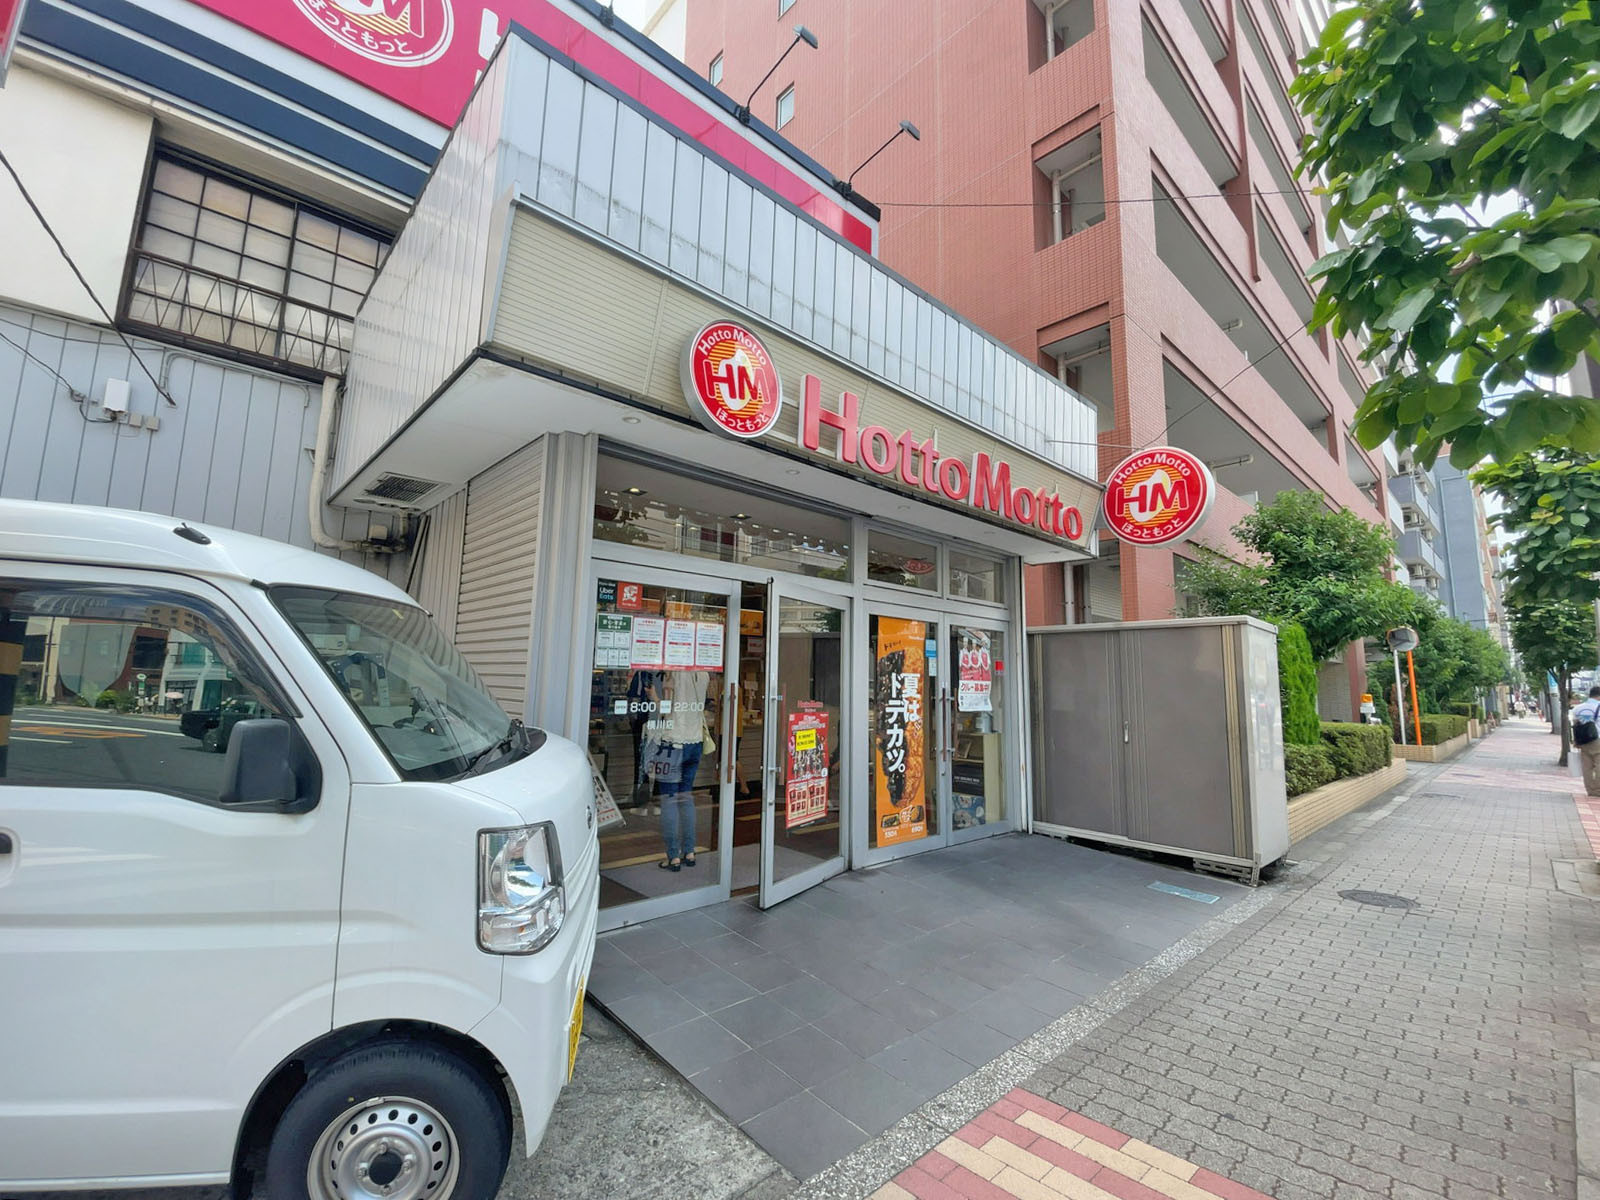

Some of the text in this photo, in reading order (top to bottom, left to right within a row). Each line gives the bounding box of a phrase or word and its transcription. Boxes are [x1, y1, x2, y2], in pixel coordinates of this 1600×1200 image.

[703, 359, 771, 404] HM
[715, 408, 770, 431] ほっともっと
[1115, 478, 1189, 517] HM
[1121, 518, 1184, 539] ほっともっと
[630, 701, 656, 713] 8:00
[673, 701, 704, 712] 22:00
[902, 673, 920, 723] 夏は
[885, 672, 906, 773] ドデカツ。
